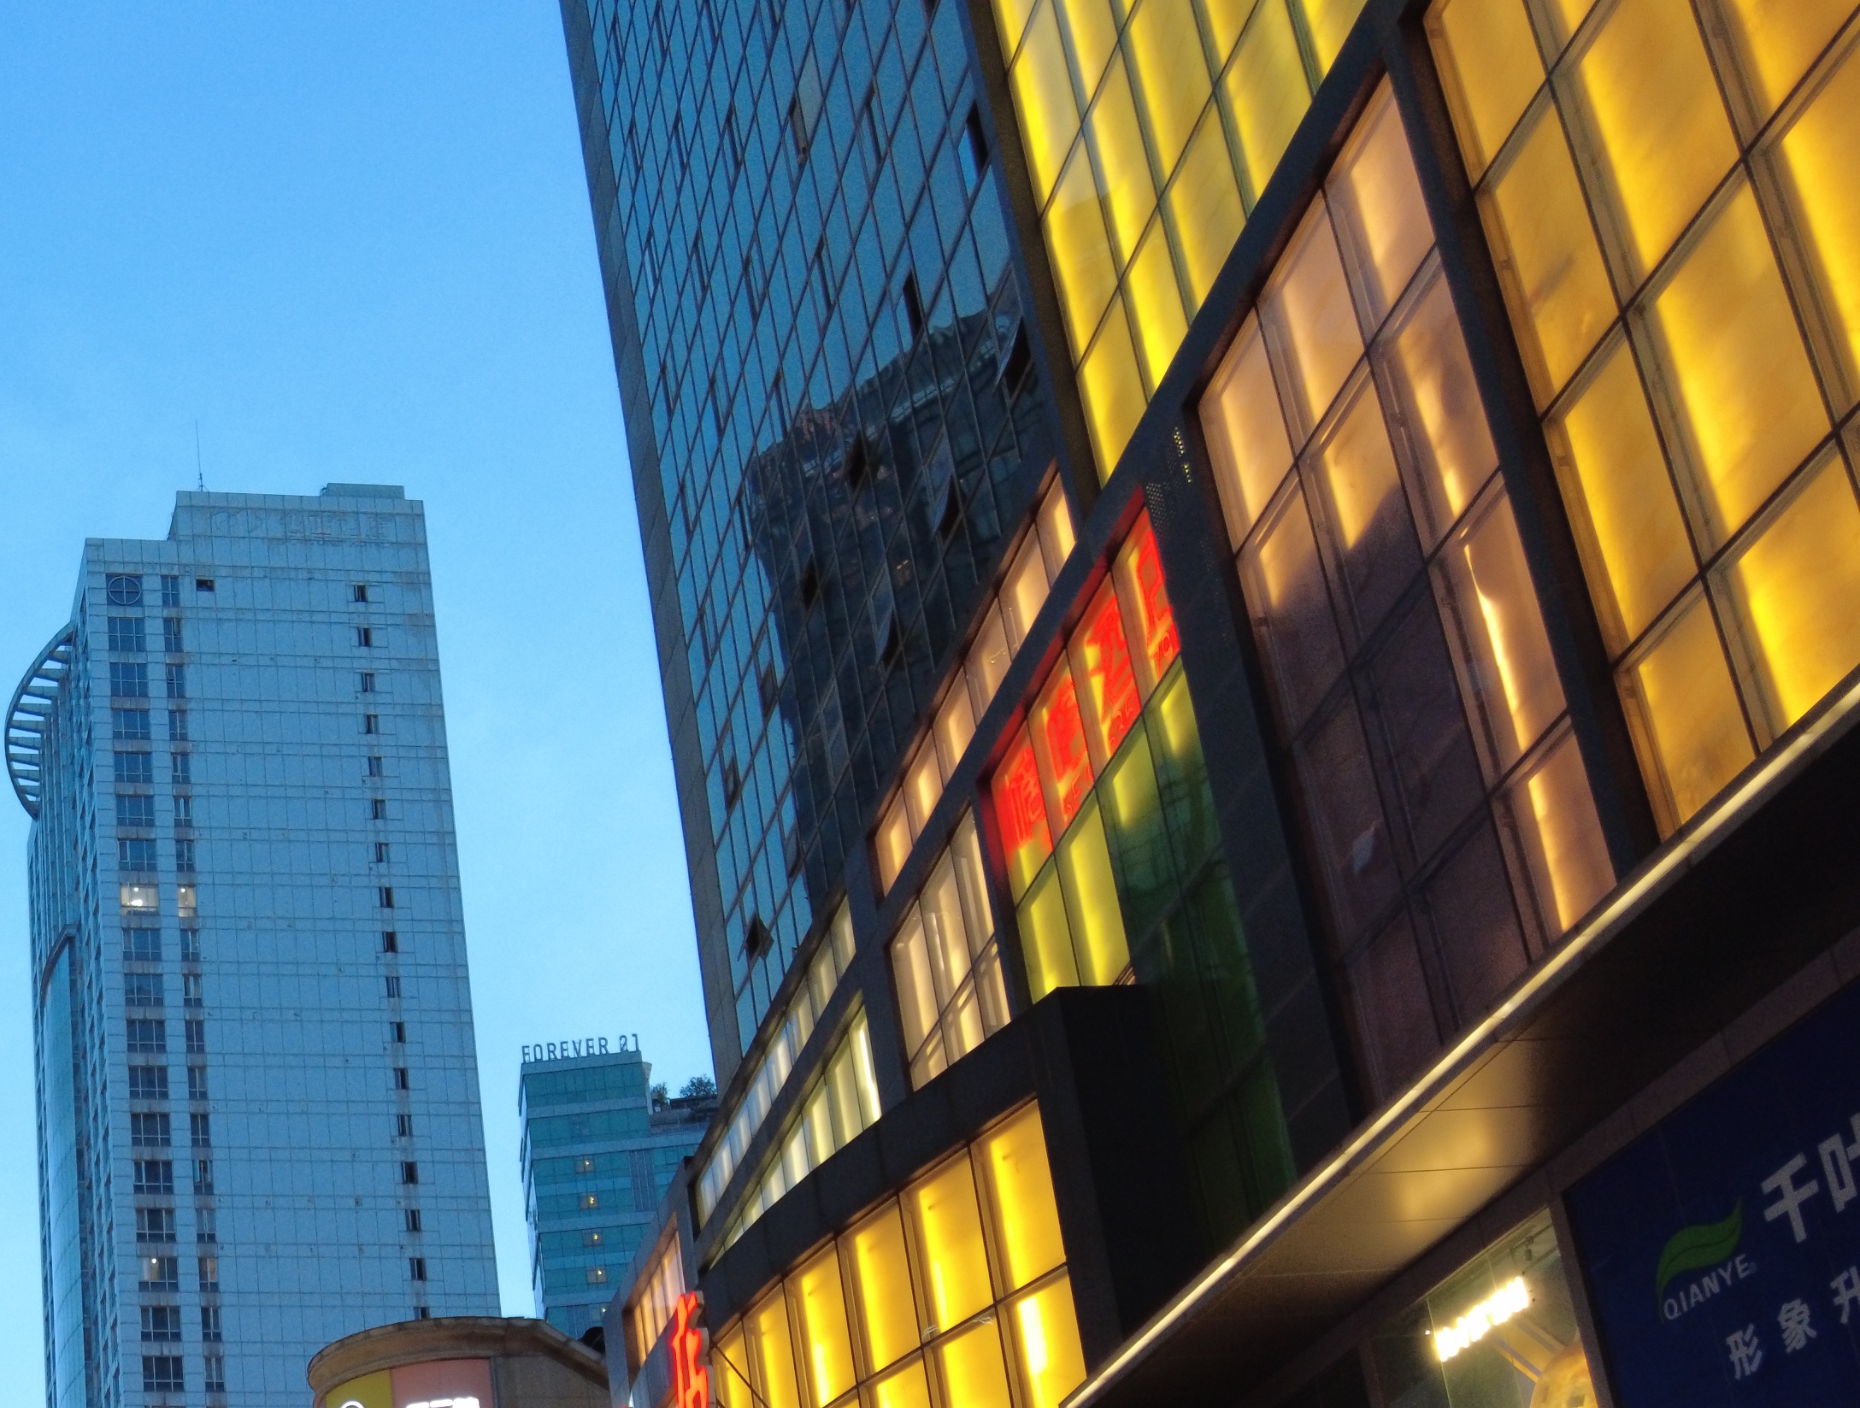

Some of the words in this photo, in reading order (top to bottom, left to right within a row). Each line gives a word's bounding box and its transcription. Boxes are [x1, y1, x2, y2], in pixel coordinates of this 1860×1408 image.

[521, 1037, 609, 1064] FOREVER
[619, 1033, 640, 1052] 21
[1663, 1253, 1749, 1321] QIANYE
